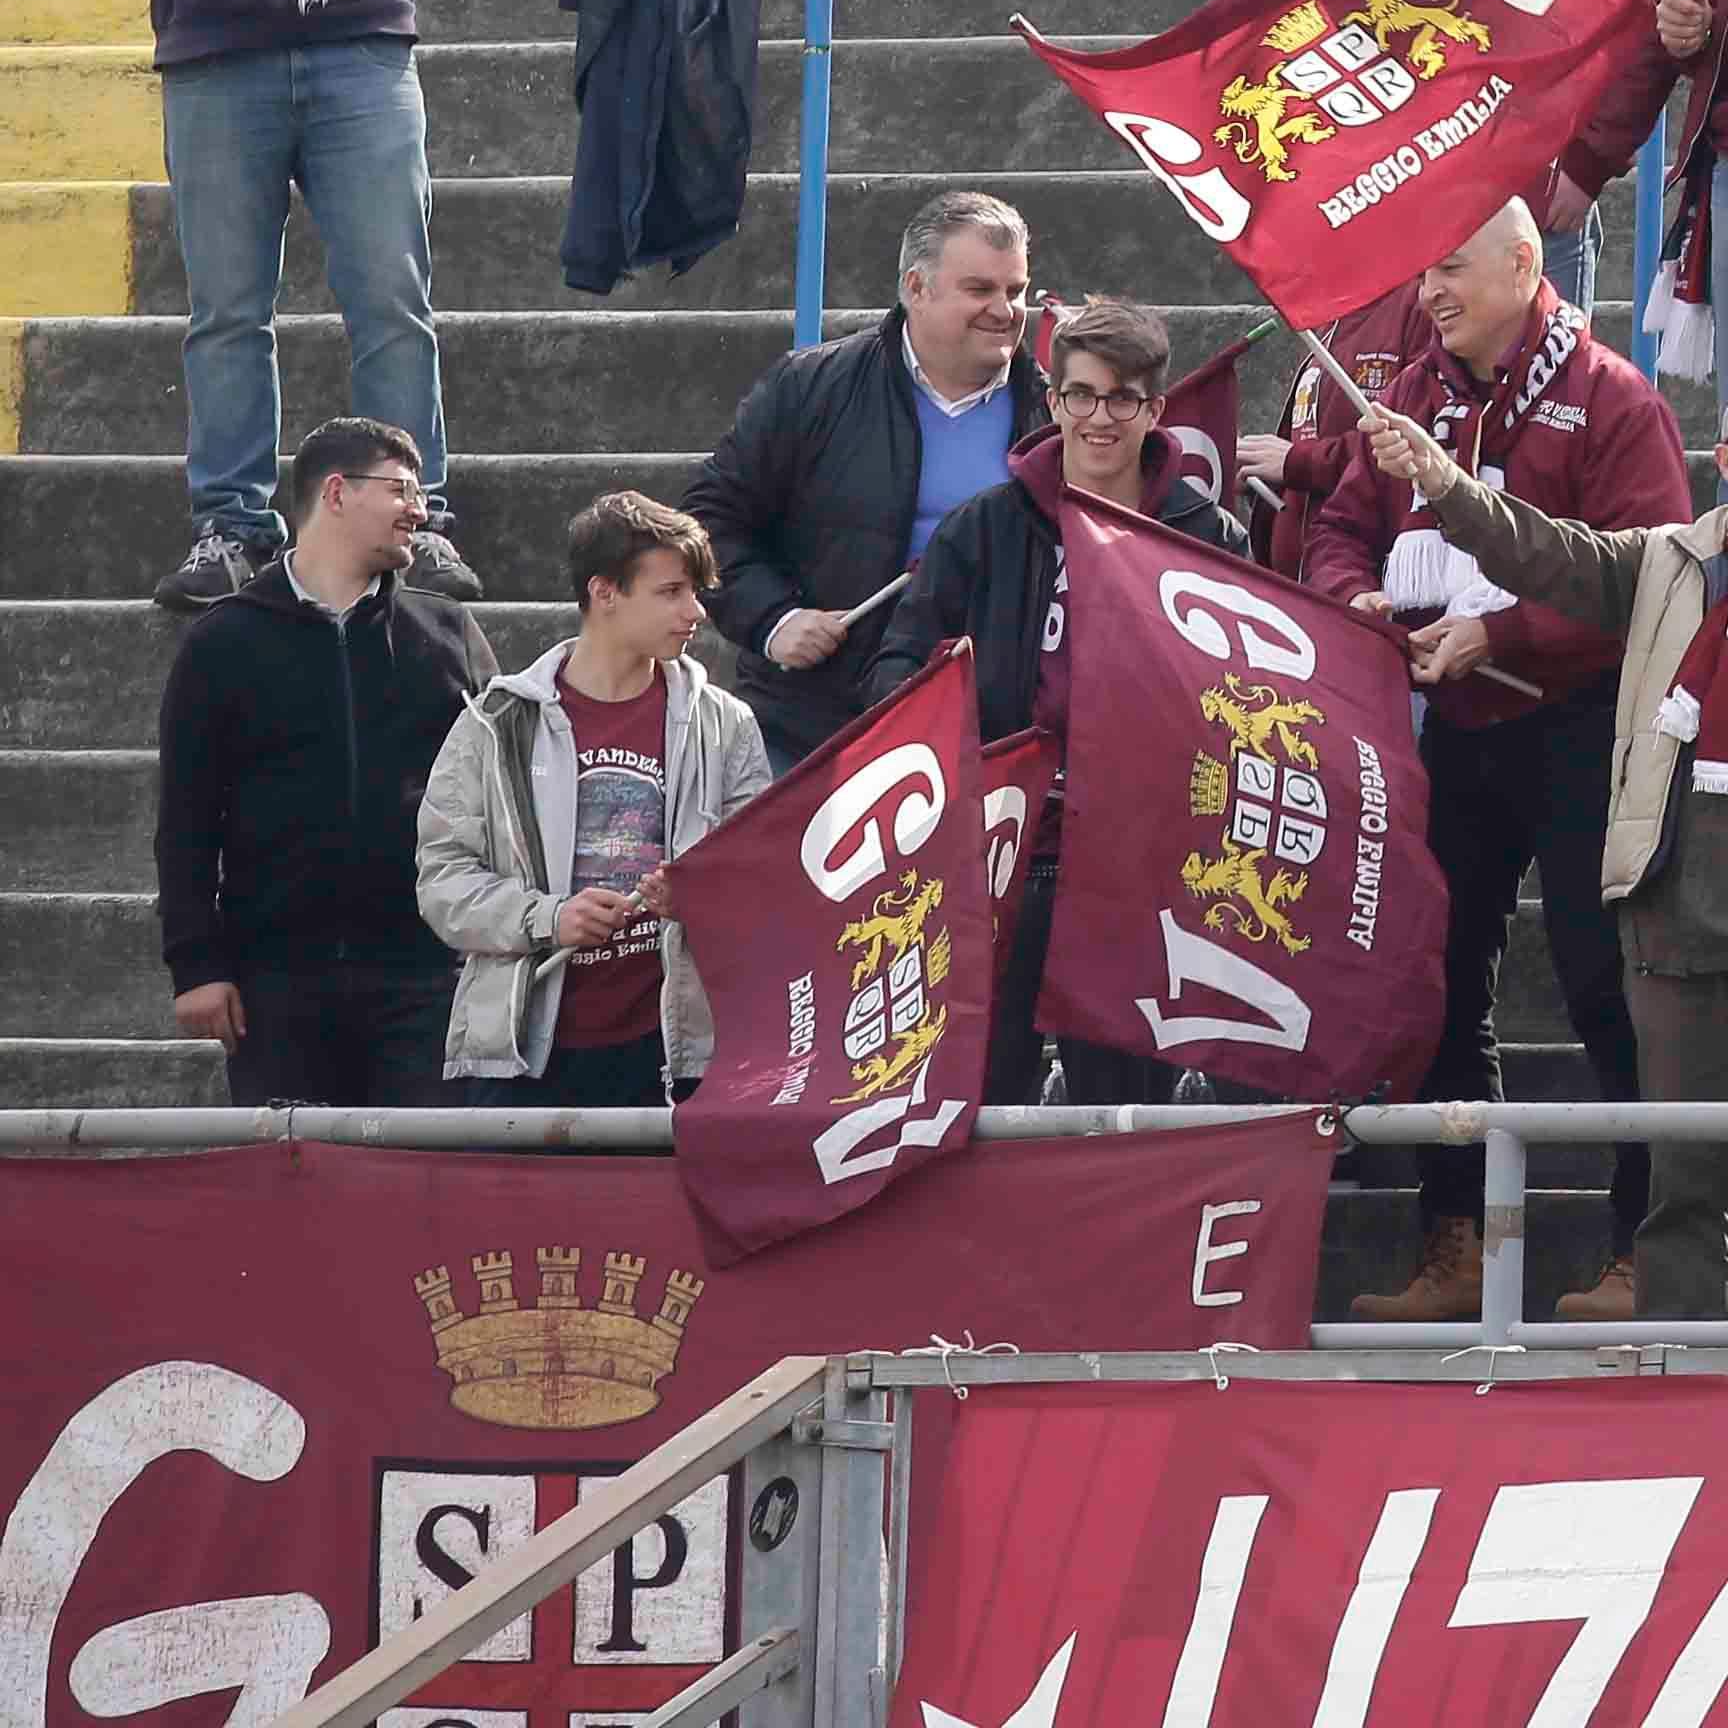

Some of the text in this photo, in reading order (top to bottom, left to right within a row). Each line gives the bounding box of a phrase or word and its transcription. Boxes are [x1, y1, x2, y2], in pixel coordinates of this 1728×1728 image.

[1295, 33, 1368, 92] S P
[1331, 63, 1413, 121] Q R
[1103, 110, 1253, 244] G
[1316, 72, 1515, 230] REGGIO EMILIA
[800, 742, 948, 903] G
[1190, 1198, 1262, 1307] E
[0, 1359, 331, 1728] G
